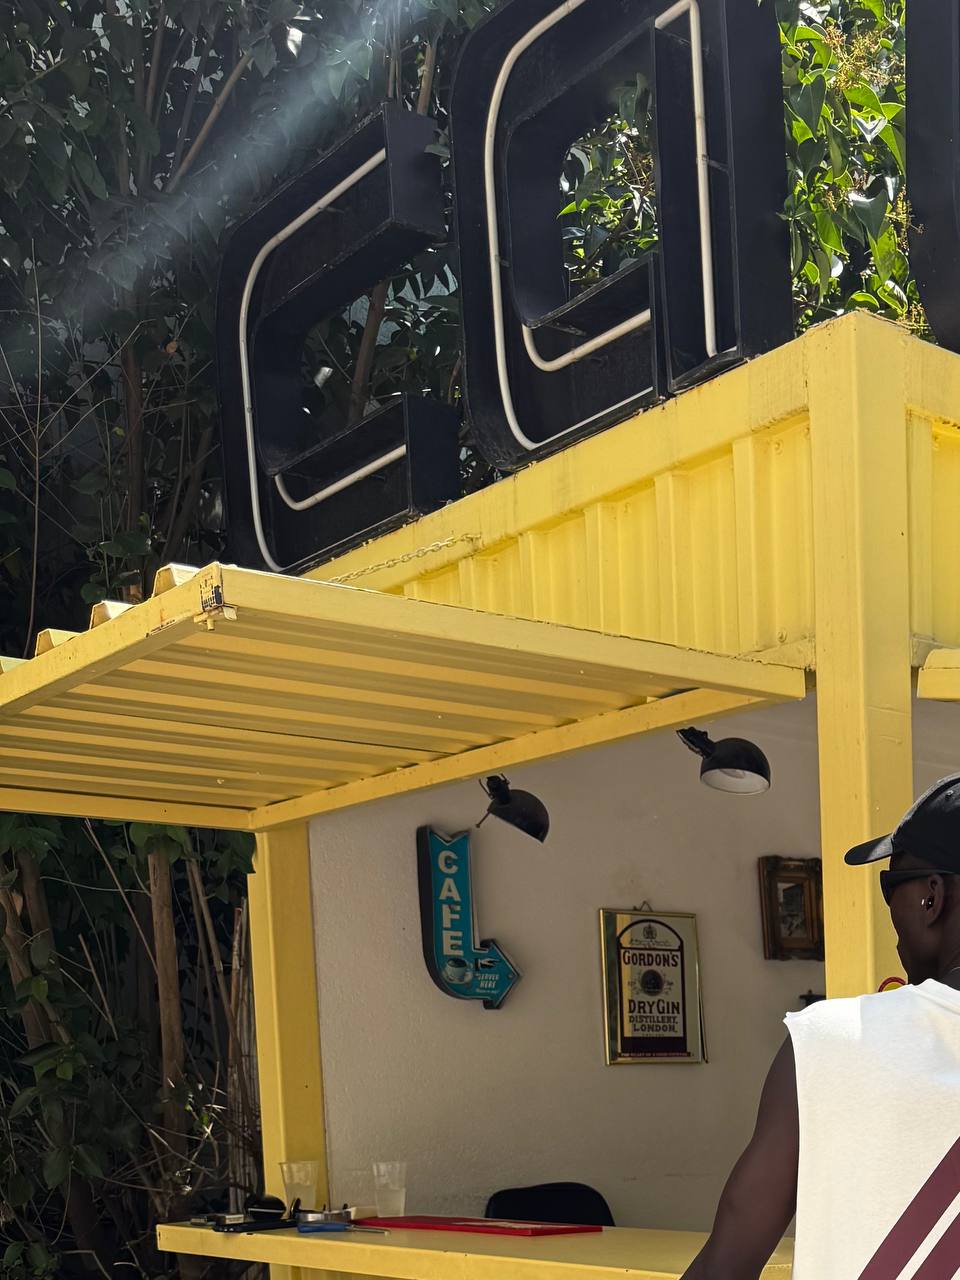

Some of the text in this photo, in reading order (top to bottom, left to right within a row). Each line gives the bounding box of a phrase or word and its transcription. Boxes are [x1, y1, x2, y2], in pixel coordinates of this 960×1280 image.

[438, 850, 464, 956] CAFE
[622, 950, 680, 968] GORDON'S
[628, 999, 680, 1015] DRY GIN
